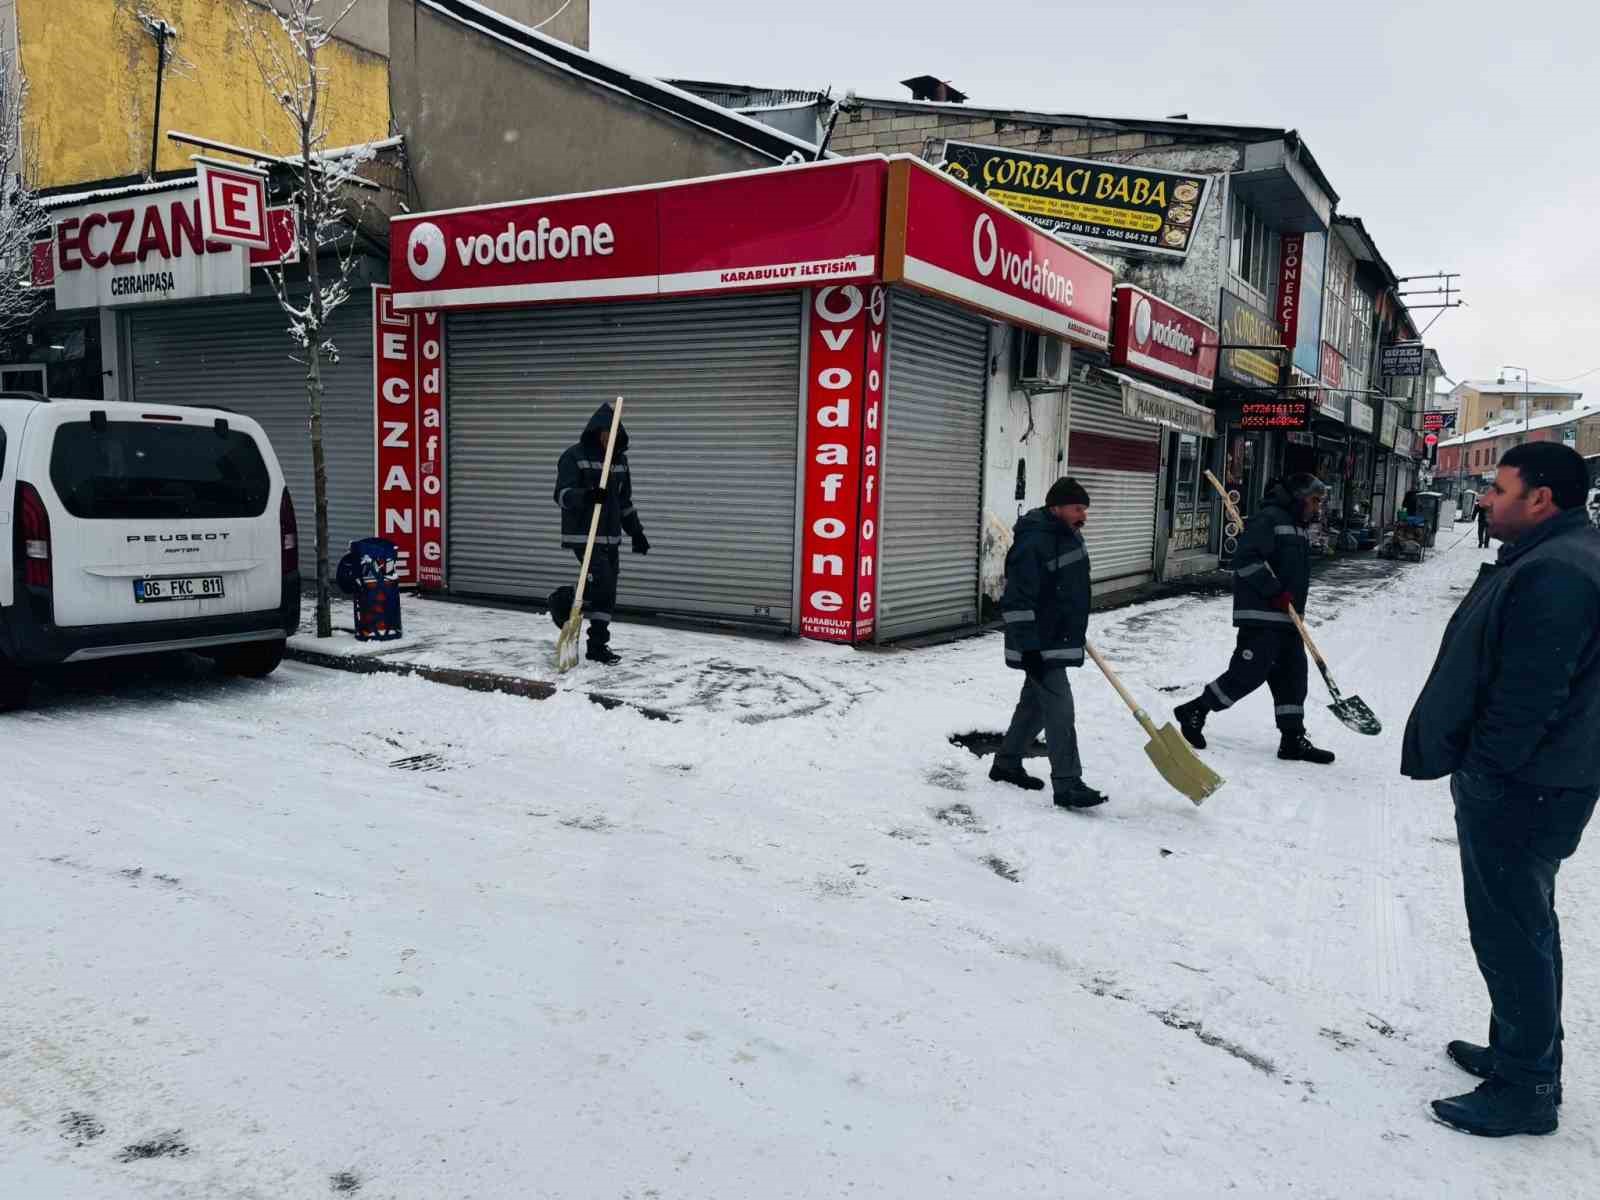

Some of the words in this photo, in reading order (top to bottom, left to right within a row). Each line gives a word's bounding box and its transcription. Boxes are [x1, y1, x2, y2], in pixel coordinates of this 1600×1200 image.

[222, 183, 250, 229] E
[983, 157, 1092, 196] ÇORBACI
[1096, 173, 1167, 209] BABA
[58, 200, 232, 271] ECZAN
[455, 218, 615, 267] vodafone
[720, 266, 797, 283] KARABULUT
[1000, 248, 1073, 307] vodafone
[1151, 320, 1195, 356] vodafone
[810, 328, 854, 613] vodafone
[858, 330, 881, 614] vodafone
[126, 532, 231, 543] PEUGEOT
[143, 582, 161, 597] 06
[170, 580, 194, 595] FKC
[202, 578, 222, 594] 811
[801, 616, 851, 628] KARABULUT
